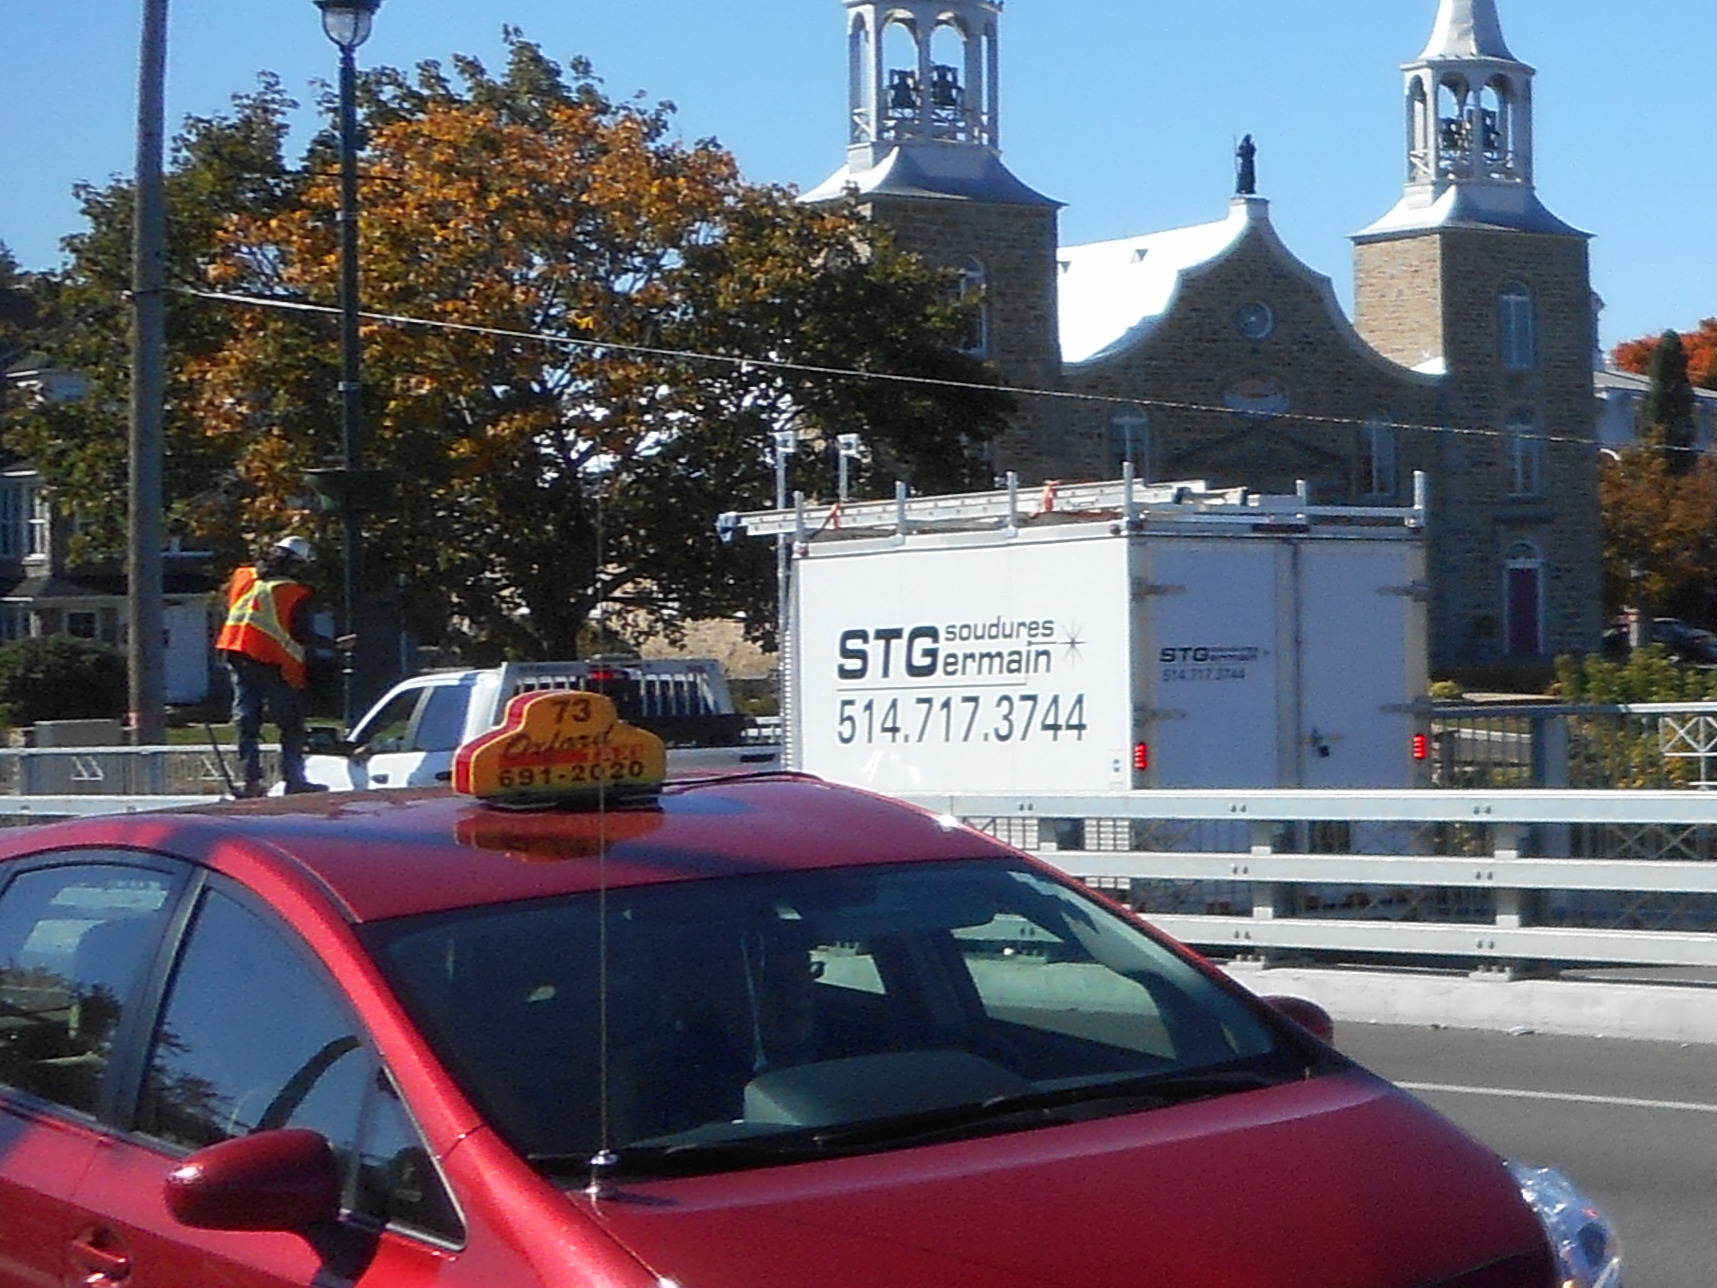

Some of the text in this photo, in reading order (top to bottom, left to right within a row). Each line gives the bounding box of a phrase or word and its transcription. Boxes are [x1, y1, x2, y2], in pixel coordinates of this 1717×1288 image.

[837, 615, 1055, 680] STG soudures
[1160, 647, 1208, 662] STG
[551, 697, 592, 724] 73
[837, 693, 1088, 745] 514.717.3744
[498, 760, 644, 788] 691-2020
